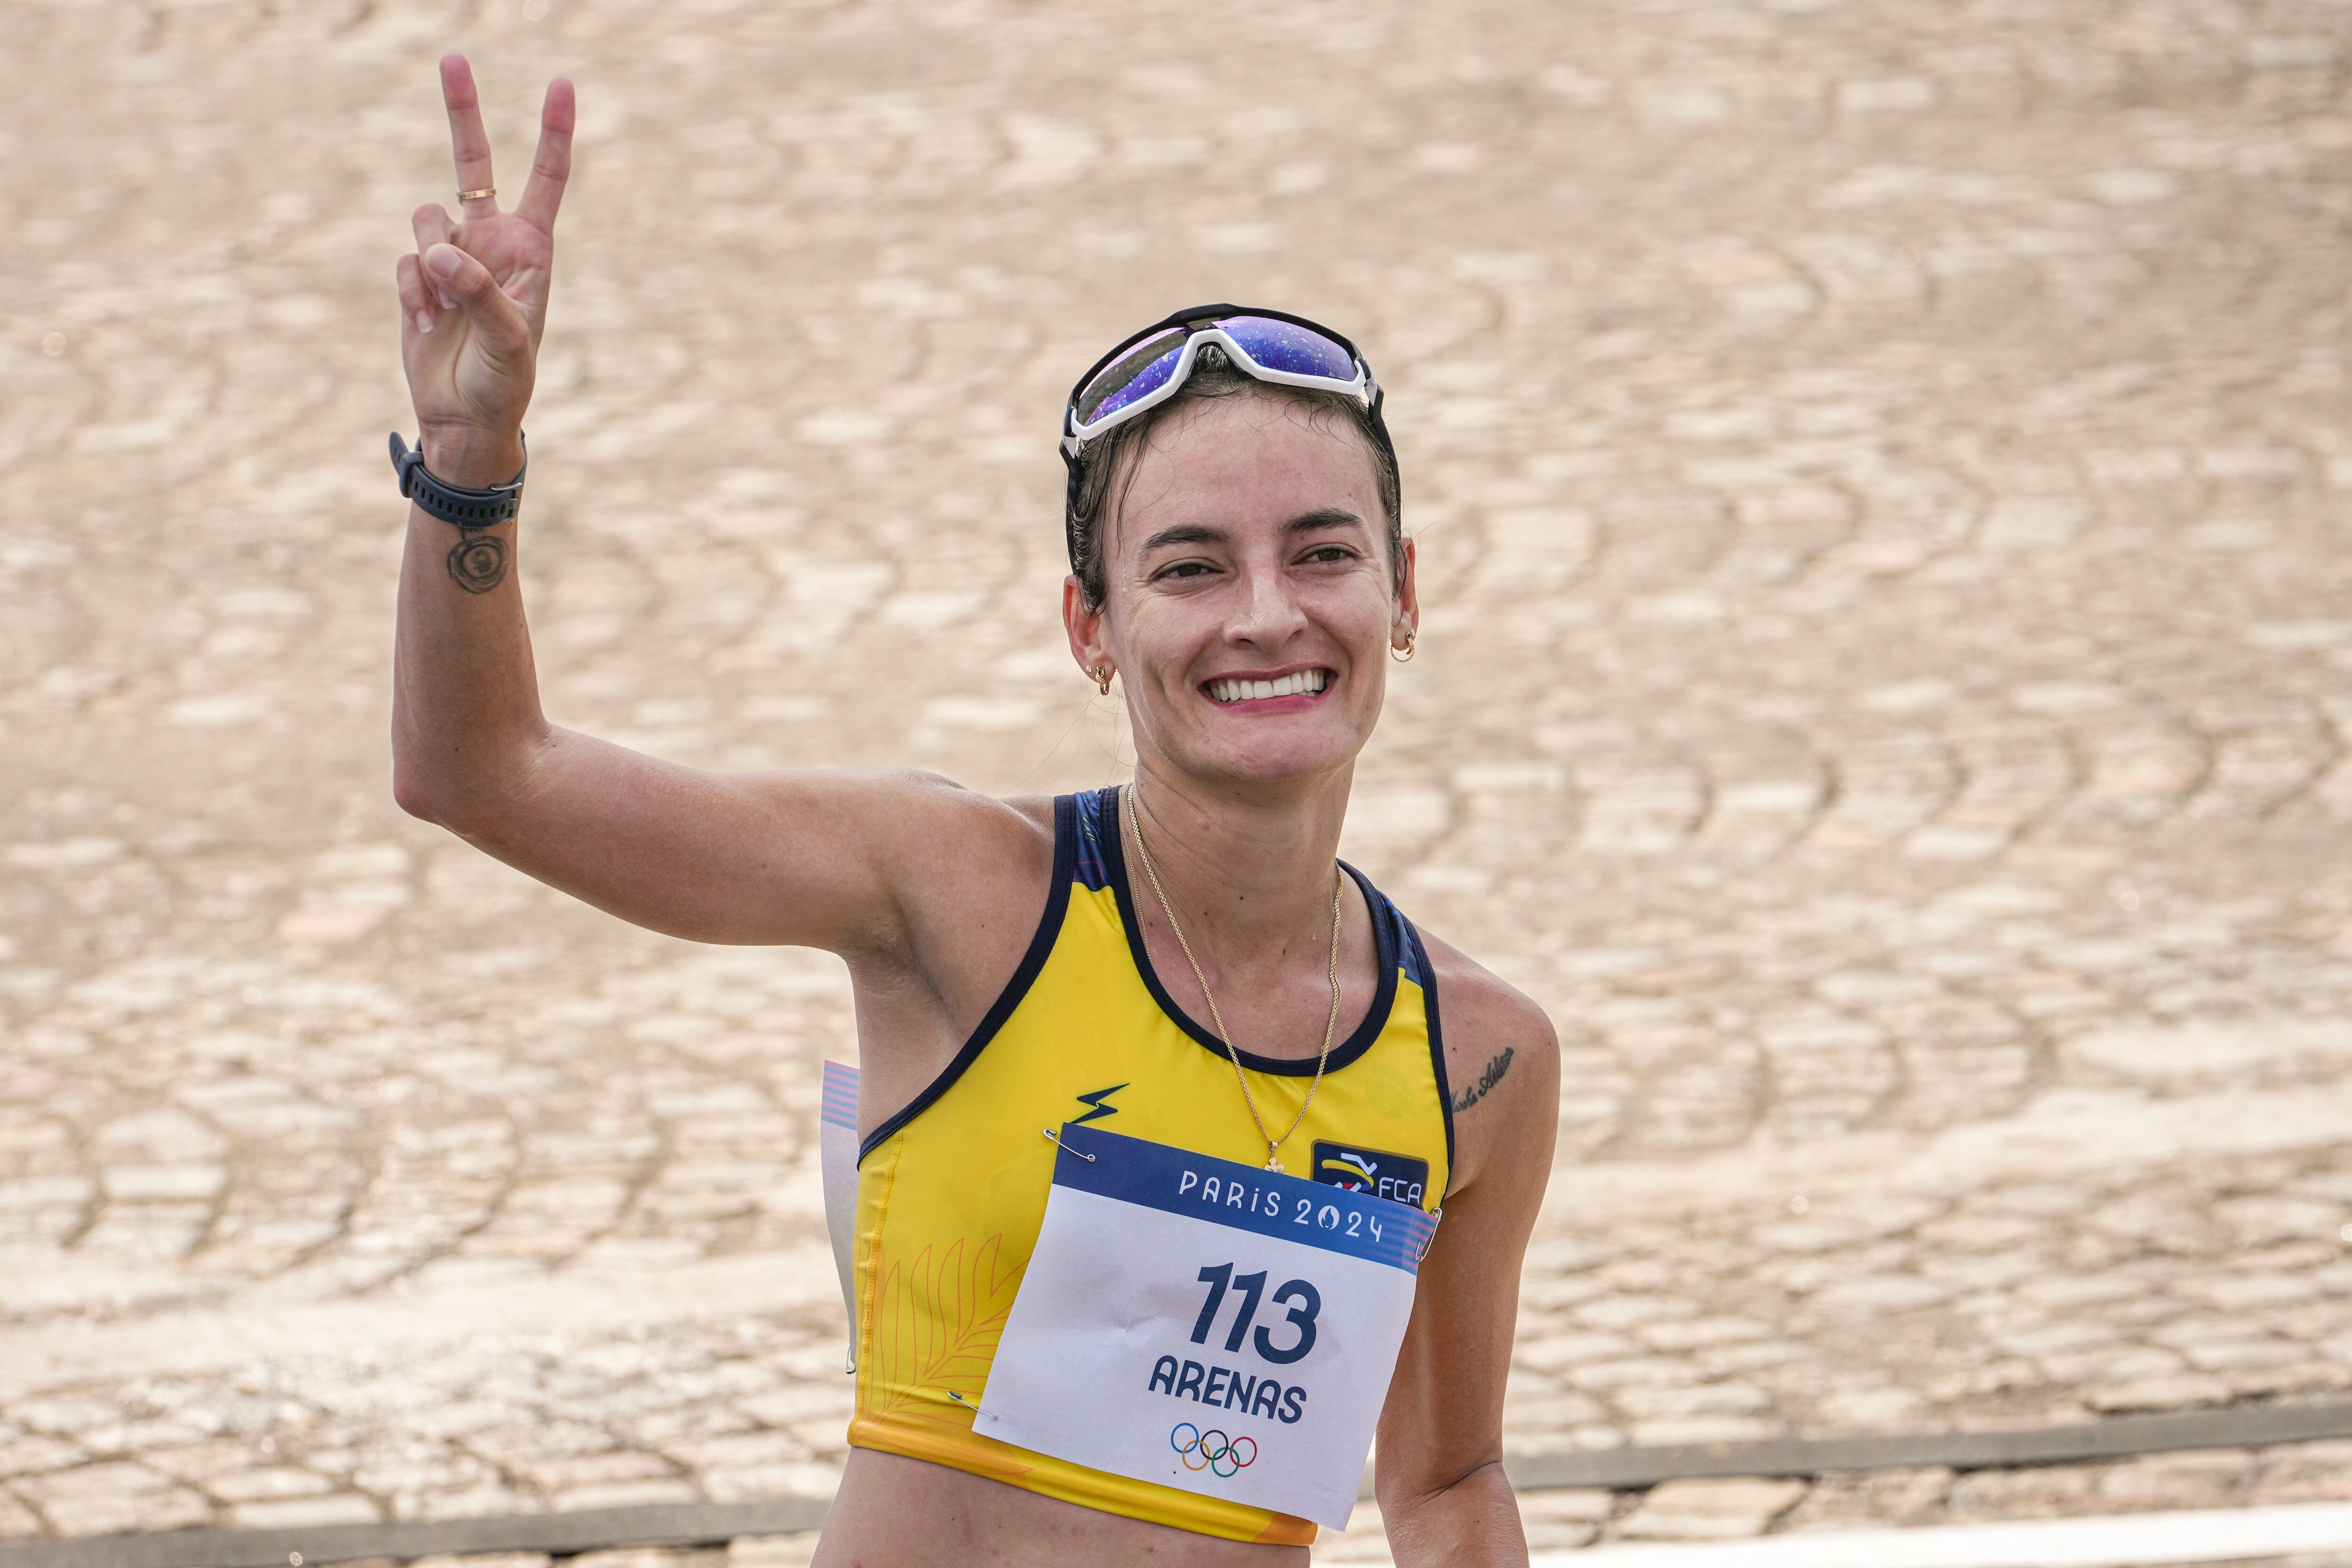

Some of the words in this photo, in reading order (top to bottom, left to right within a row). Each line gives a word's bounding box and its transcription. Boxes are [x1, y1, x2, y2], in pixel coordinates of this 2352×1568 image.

[1379, 1176, 1420, 1204] FCA
[1294, 1198, 1383, 1243] 2024
[1190, 1262, 1321, 1364] 113
[1148, 1354, 1307, 1424] ARENAS
